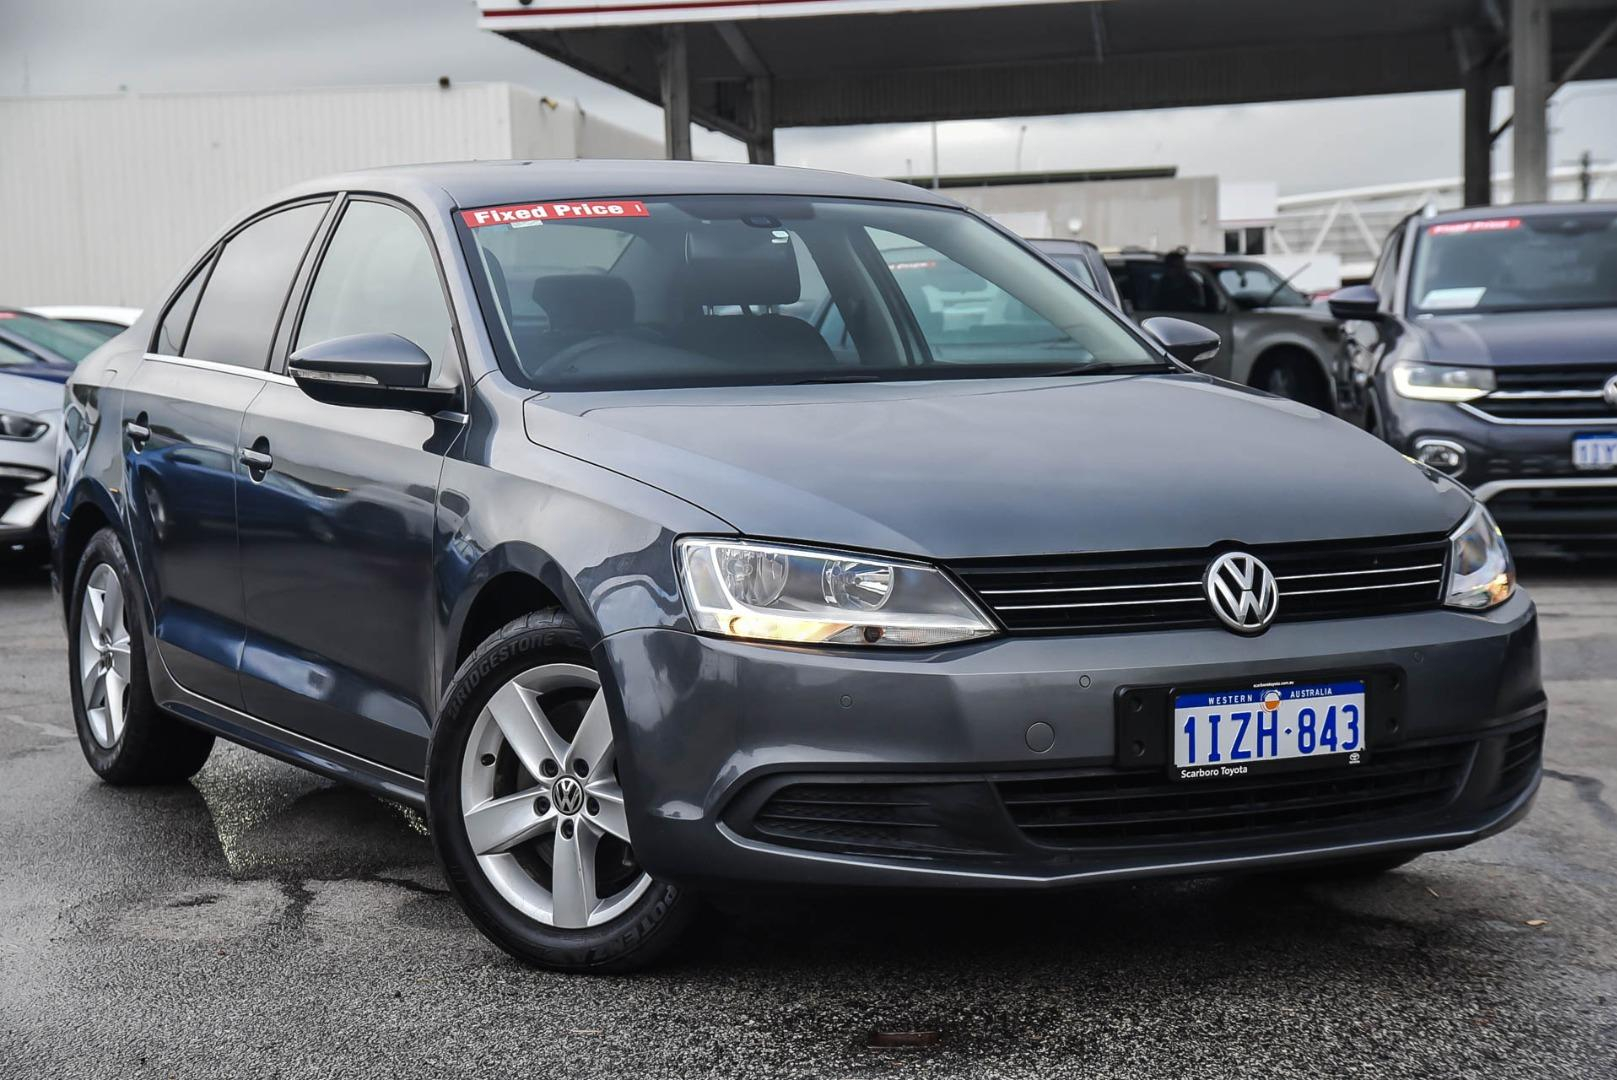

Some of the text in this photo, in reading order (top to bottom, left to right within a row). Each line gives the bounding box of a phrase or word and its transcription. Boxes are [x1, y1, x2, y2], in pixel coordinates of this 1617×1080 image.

[474, 203, 624, 224] Fixed Price
[1208, 687, 1333, 705] WESTERN AUSTRALIA
[1180, 765, 1248, 779] Scarboro Toyota
